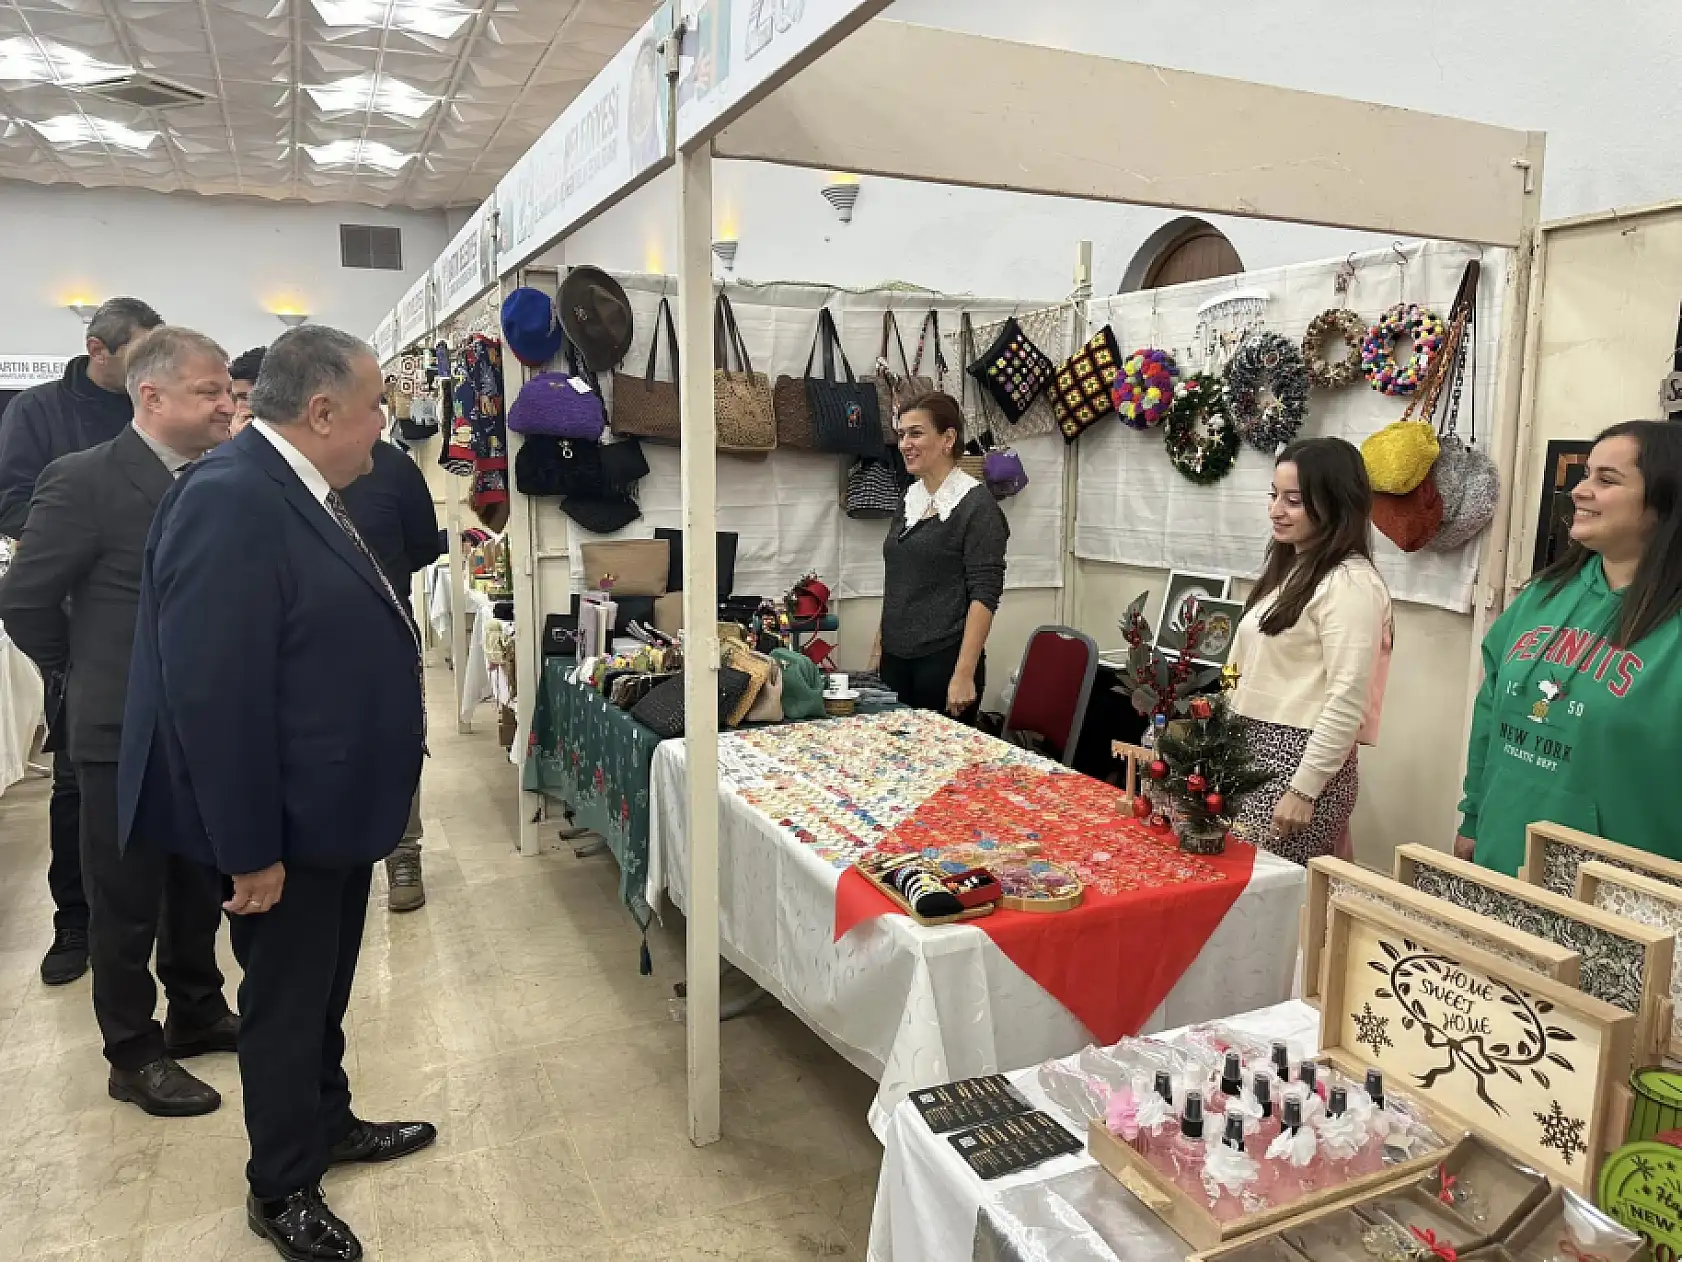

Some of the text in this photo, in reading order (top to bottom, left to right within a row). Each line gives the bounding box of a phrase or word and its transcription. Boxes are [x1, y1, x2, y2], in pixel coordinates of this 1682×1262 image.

[1567, 700, 1586, 717] 50
[1500, 722, 1573, 763] NEW YORK
[1419, 978, 1476, 1015] SWEET
[1441, 965, 1493, 1001] HOME
[1442, 1011, 1493, 1035] HOME
[1630, 1203, 1676, 1233] NEW
